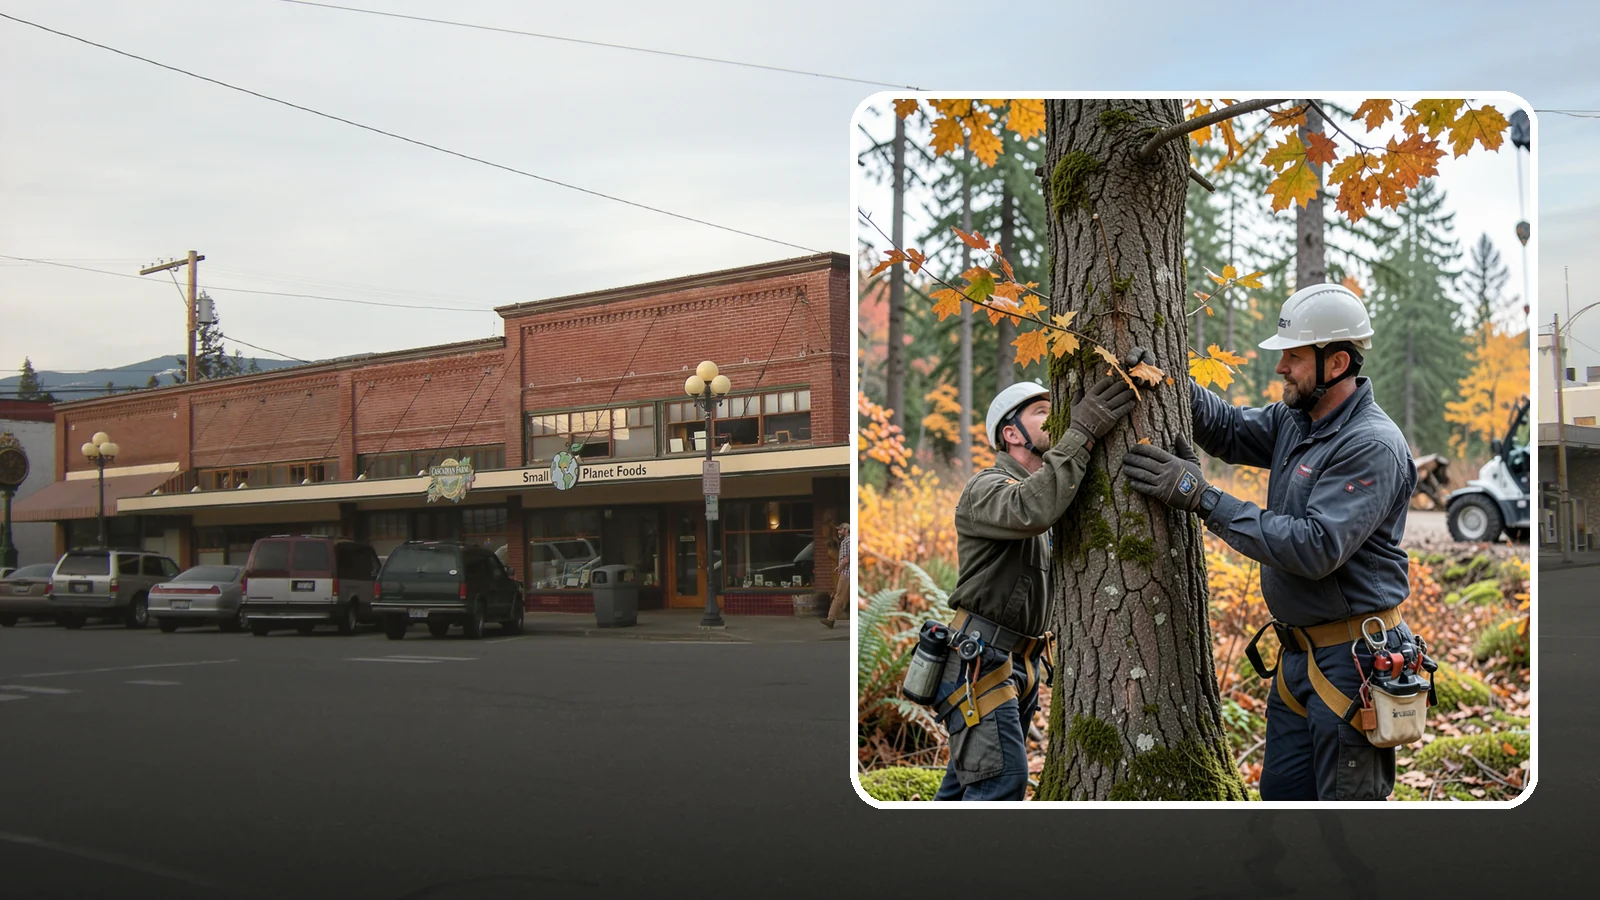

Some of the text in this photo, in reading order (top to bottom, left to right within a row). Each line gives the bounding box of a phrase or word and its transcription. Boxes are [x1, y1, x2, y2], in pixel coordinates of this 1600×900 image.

[523, 464, 647, 483] Small Planet Foods
